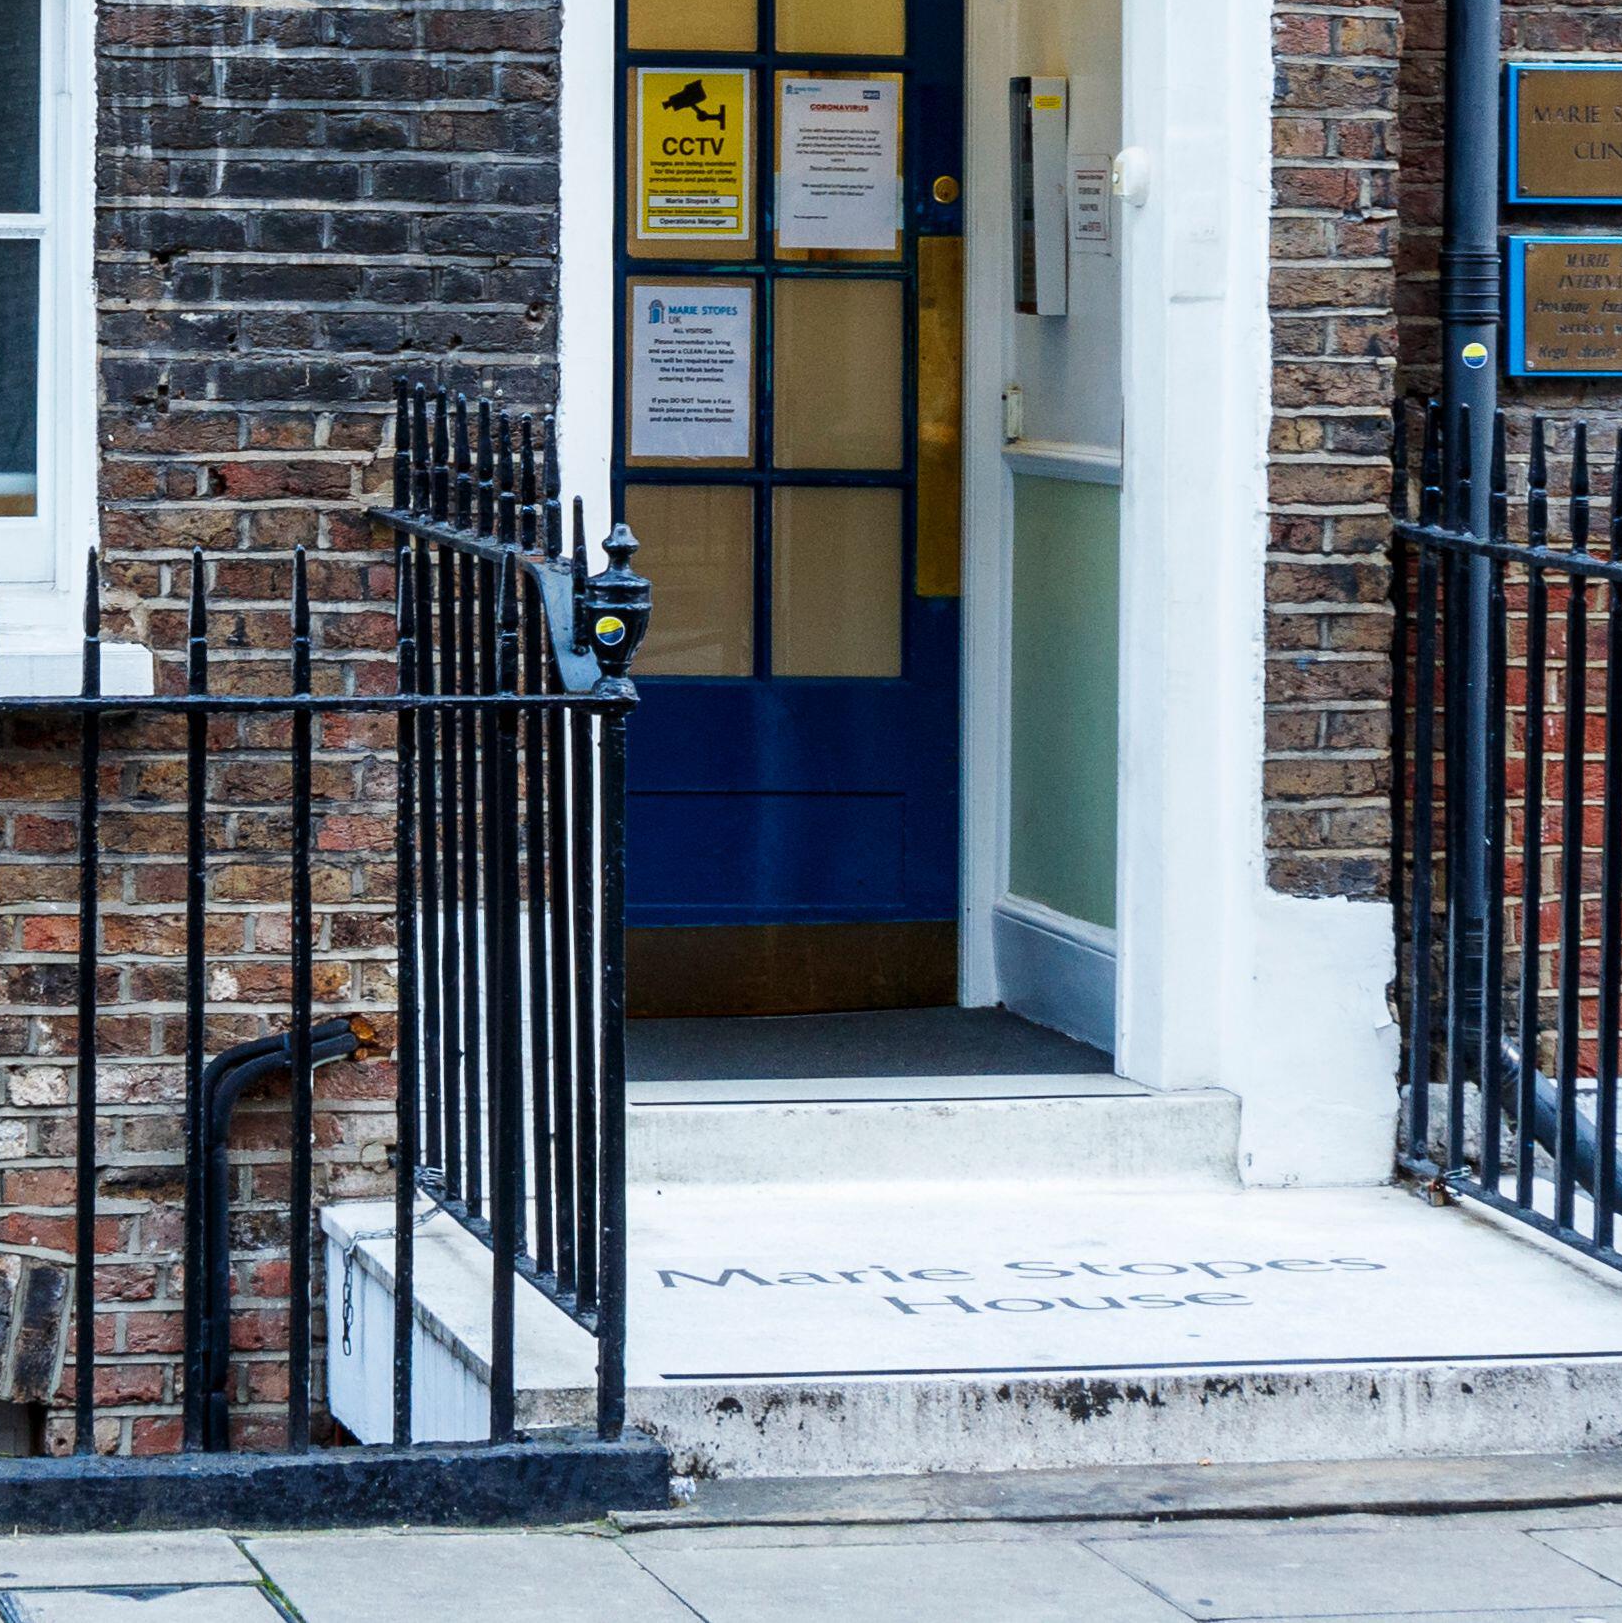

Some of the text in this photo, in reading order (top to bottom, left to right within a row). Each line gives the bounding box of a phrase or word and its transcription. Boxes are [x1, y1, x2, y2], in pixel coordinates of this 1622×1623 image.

[810, 103, 869, 113] CORONAVIRUS
[1532, 105, 1602, 125] MARIE
[662, 137, 724, 155] CCTV
[1565, 253, 1609, 268] MARIE
[668, 306, 738, 315] MARIE STOPES
[668, 316, 681, 324] UK
[656, 1255, 1387, 1289] Marie Stopes
[884, 1288, 1254, 1316] House
